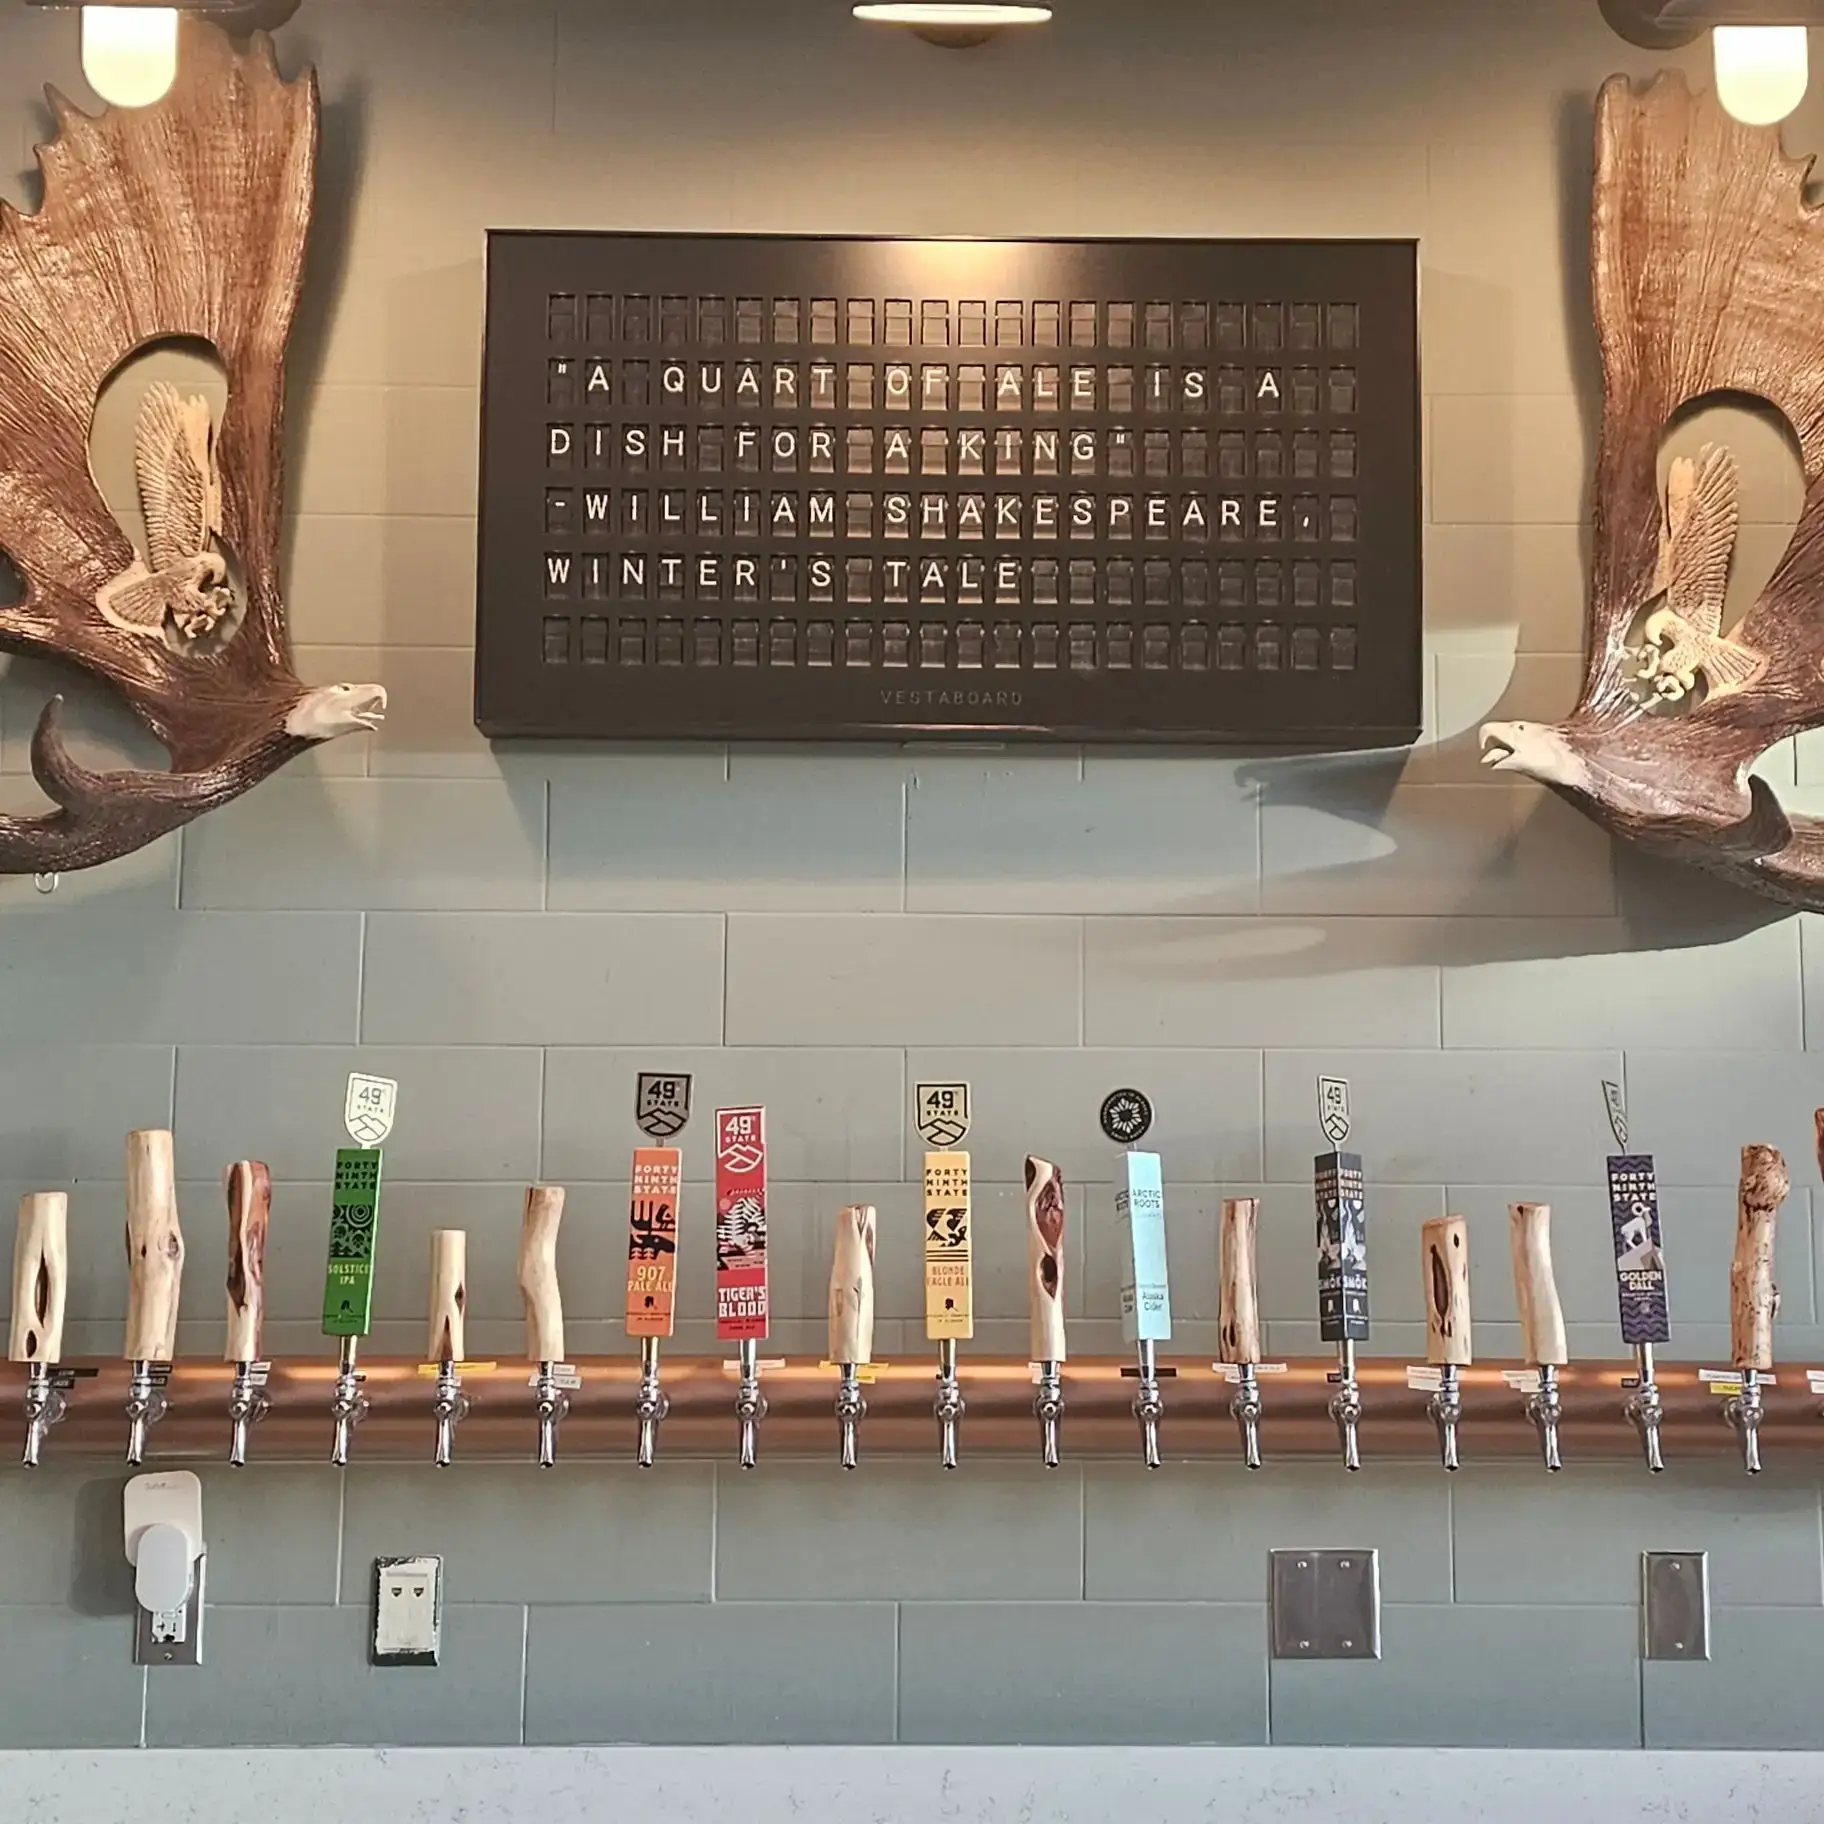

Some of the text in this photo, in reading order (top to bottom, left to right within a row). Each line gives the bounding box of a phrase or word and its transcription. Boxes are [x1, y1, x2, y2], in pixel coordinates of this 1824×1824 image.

[557, 363, 1280, 398] "A QUART OF ALE IS A
[550, 428, 1126, 461] DISH FOR A KING"
[886, 496, 1310, 528] SHAKESPEARE,
[547, 558, 1017, 588] WINTER'S TALE
[880, 689, 1022, 706] VESTABOARD
[646, 1100, 679, 1108] STATE
[926, 1109, 959, 1117] STATE
[725, 1133, 757, 1144] STATE
[635, 1164, 679, 1174] FORTY
[926, 1168, 968, 1177] FORTY
[634, 1174, 679, 1184] NINTH
[1611, 1172, 1655, 1182] FORTY
[926, 1178, 968, 1187] NINTH
[1612, 1182, 1656, 1192] NINTH
[633, 1185, 678, 1195] STATE
[926, 1188, 968, 1197] STATE
[1132, 1188, 1161, 1199] ARCTIC
[1613, 1192, 1657, 1202] STATE
[1133, 1199, 1160, 1209] ROOTS
[636, 1265, 667, 1281] 907
[1620, 1271, 1662, 1282] GOLDEN
[340, 1275, 356, 1285] IPA
[627, 1280, 652, 1293] PALE
[718, 1286, 767, 1302] TIGER'S
[719, 1301, 767, 1318] BLOOD
